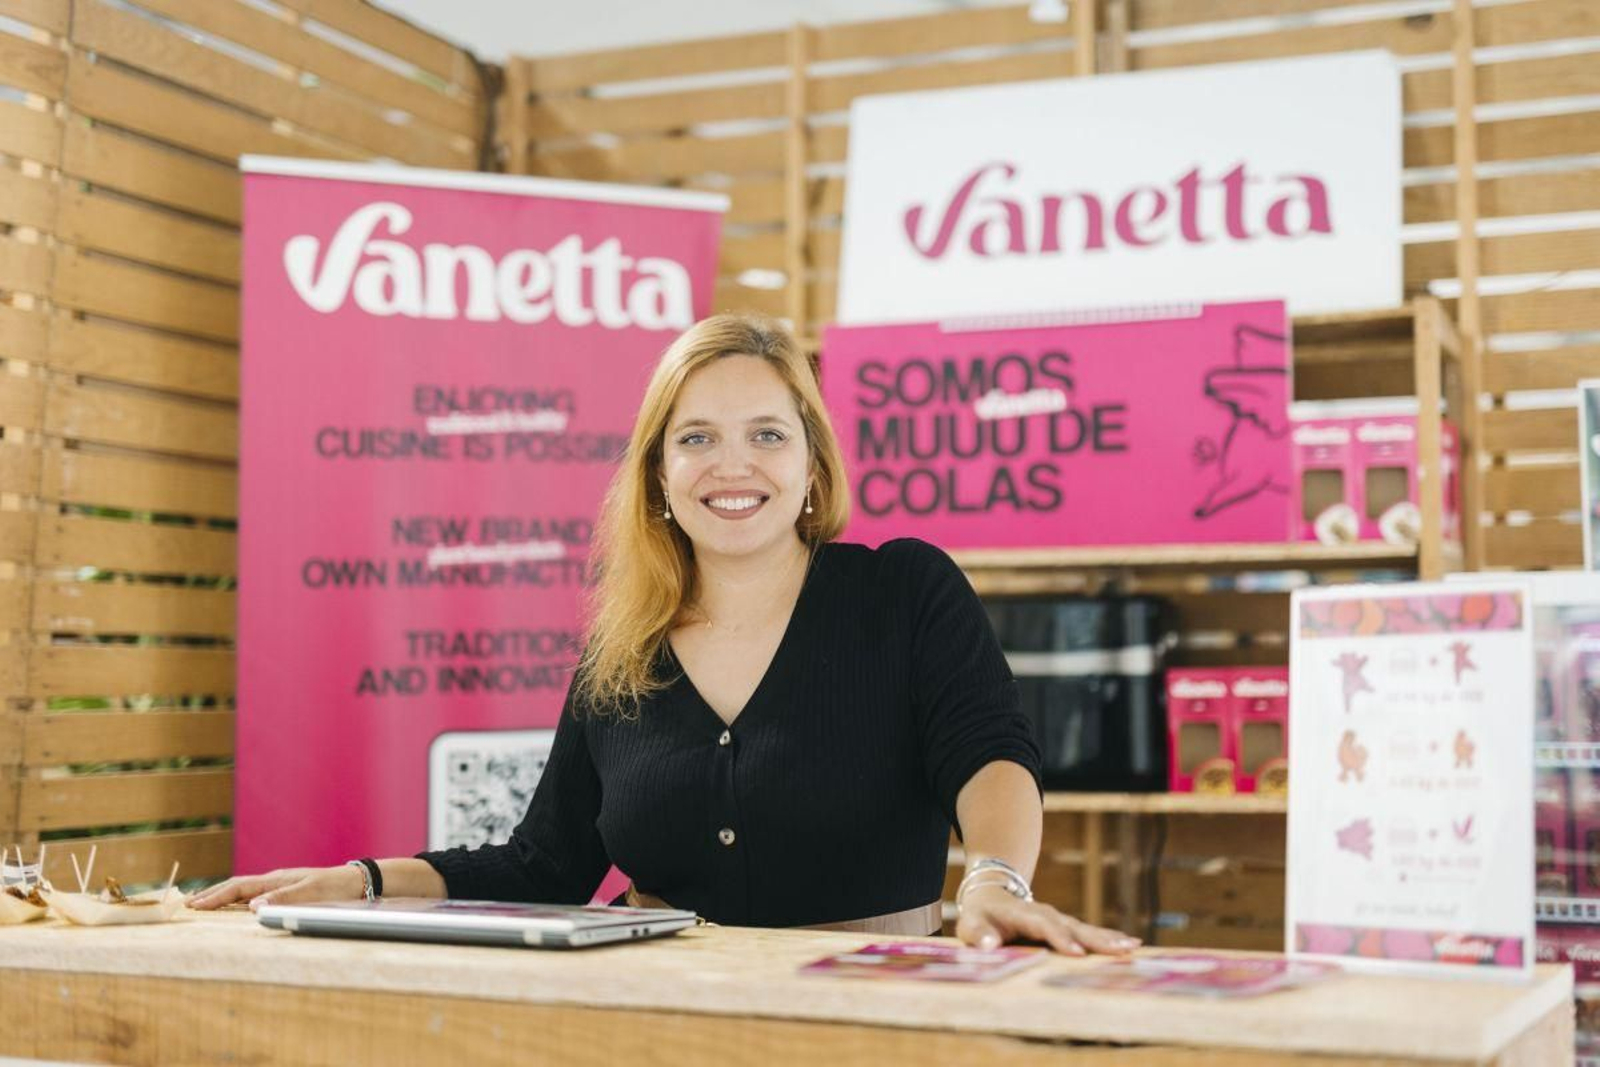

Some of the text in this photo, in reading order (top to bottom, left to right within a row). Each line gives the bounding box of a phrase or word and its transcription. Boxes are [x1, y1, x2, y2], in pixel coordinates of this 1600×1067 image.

[903, 162, 1334, 260] Vanetta
[283, 202, 696, 331] Vanetta
[855, 351, 1076, 409] SOMOS
[315, 426, 452, 461] CUISINE
[462, 431, 496, 462] IS
[857, 404, 1129, 461] MUUU DE
[857, 463, 1064, 518] COLAS
[392, 517, 593, 546] NEW BRAND
[302, 558, 387, 588] OWN
[356, 667, 427, 695] AND
